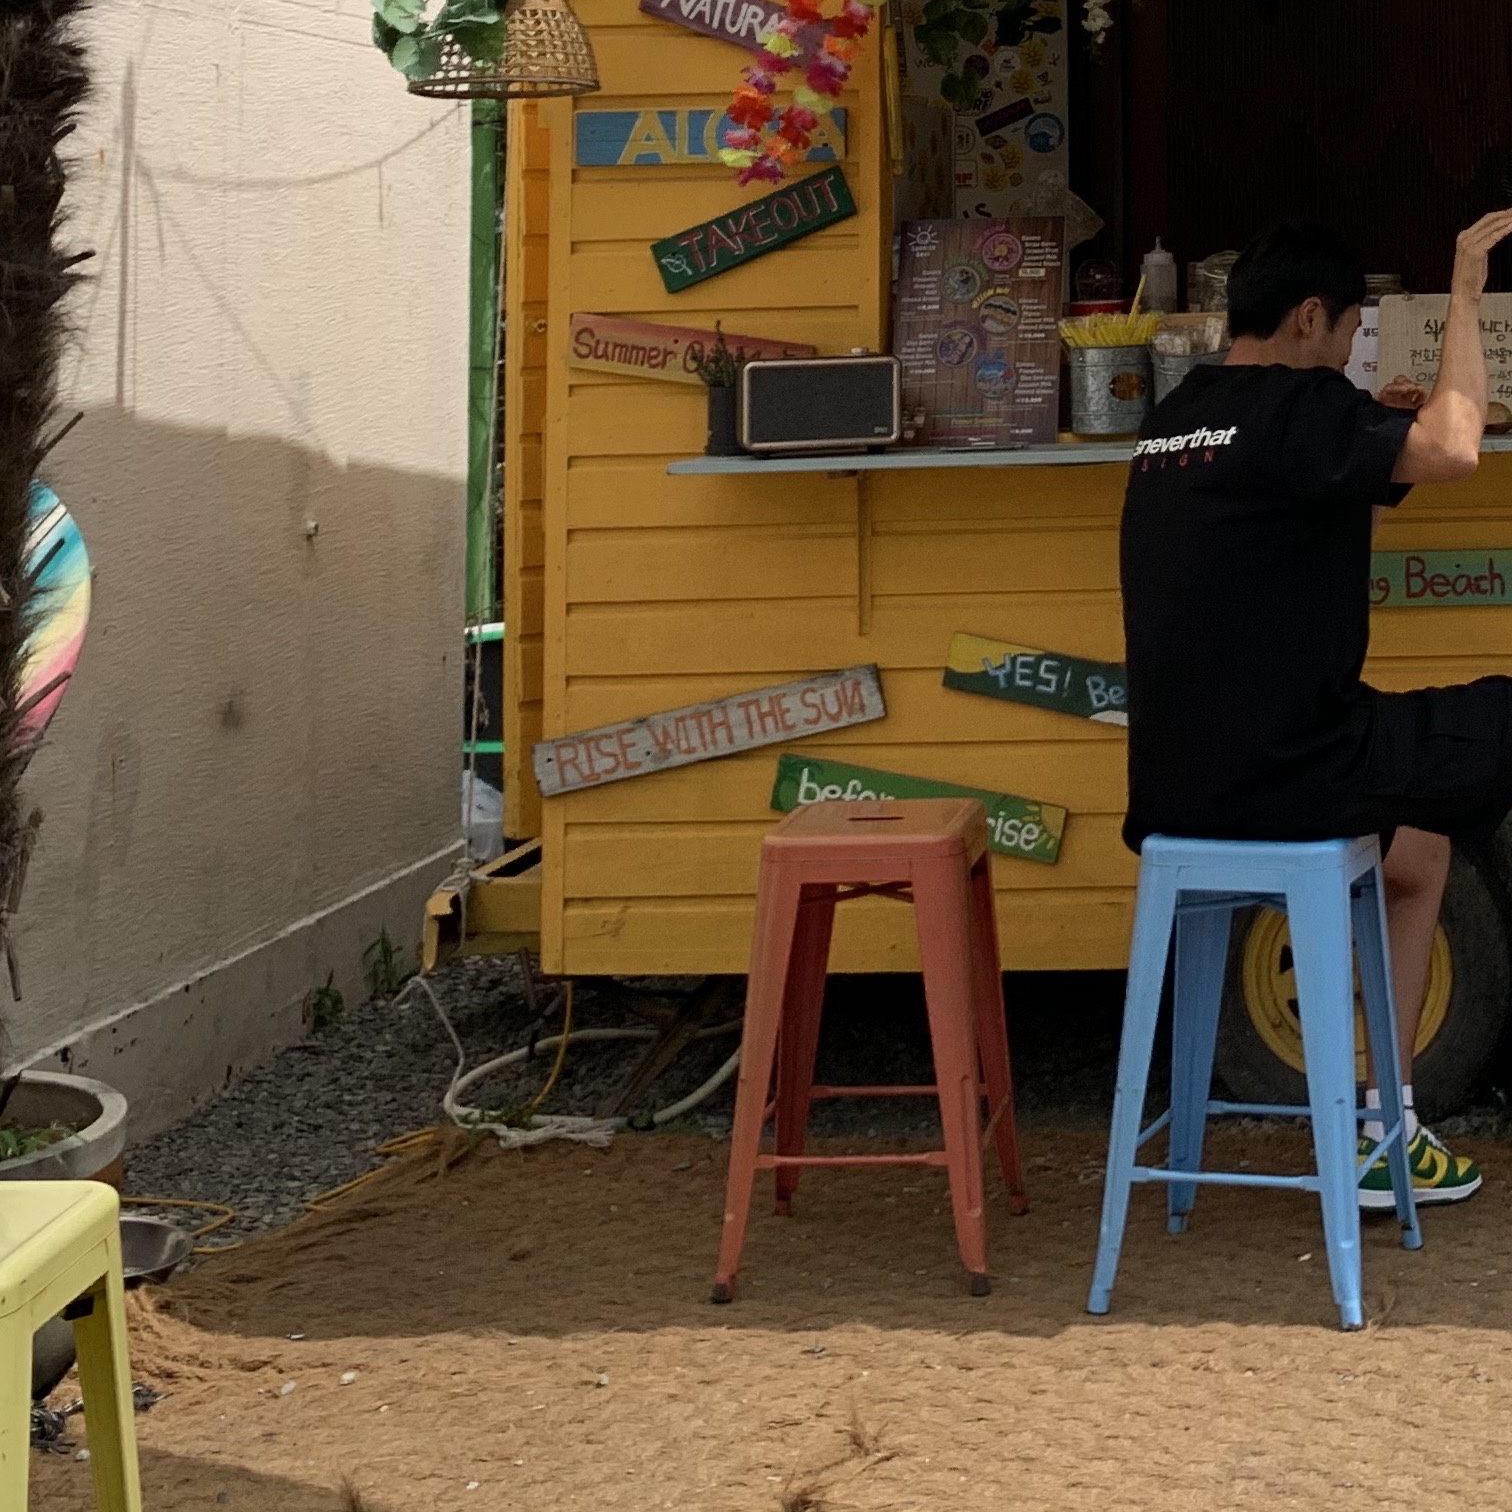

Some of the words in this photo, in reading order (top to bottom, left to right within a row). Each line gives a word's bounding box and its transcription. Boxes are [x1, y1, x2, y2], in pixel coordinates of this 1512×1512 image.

[679, 175, 838, 273] TAKEOUT
[572, 327, 677, 369] Summer
[1403, 555, 1507, 599] Beach
[981, 652, 1073, 698] YES!
[553, 728, 641, 788] RISE
[645, 708, 735, 756] WITH
[736, 695, 800, 740] THE
